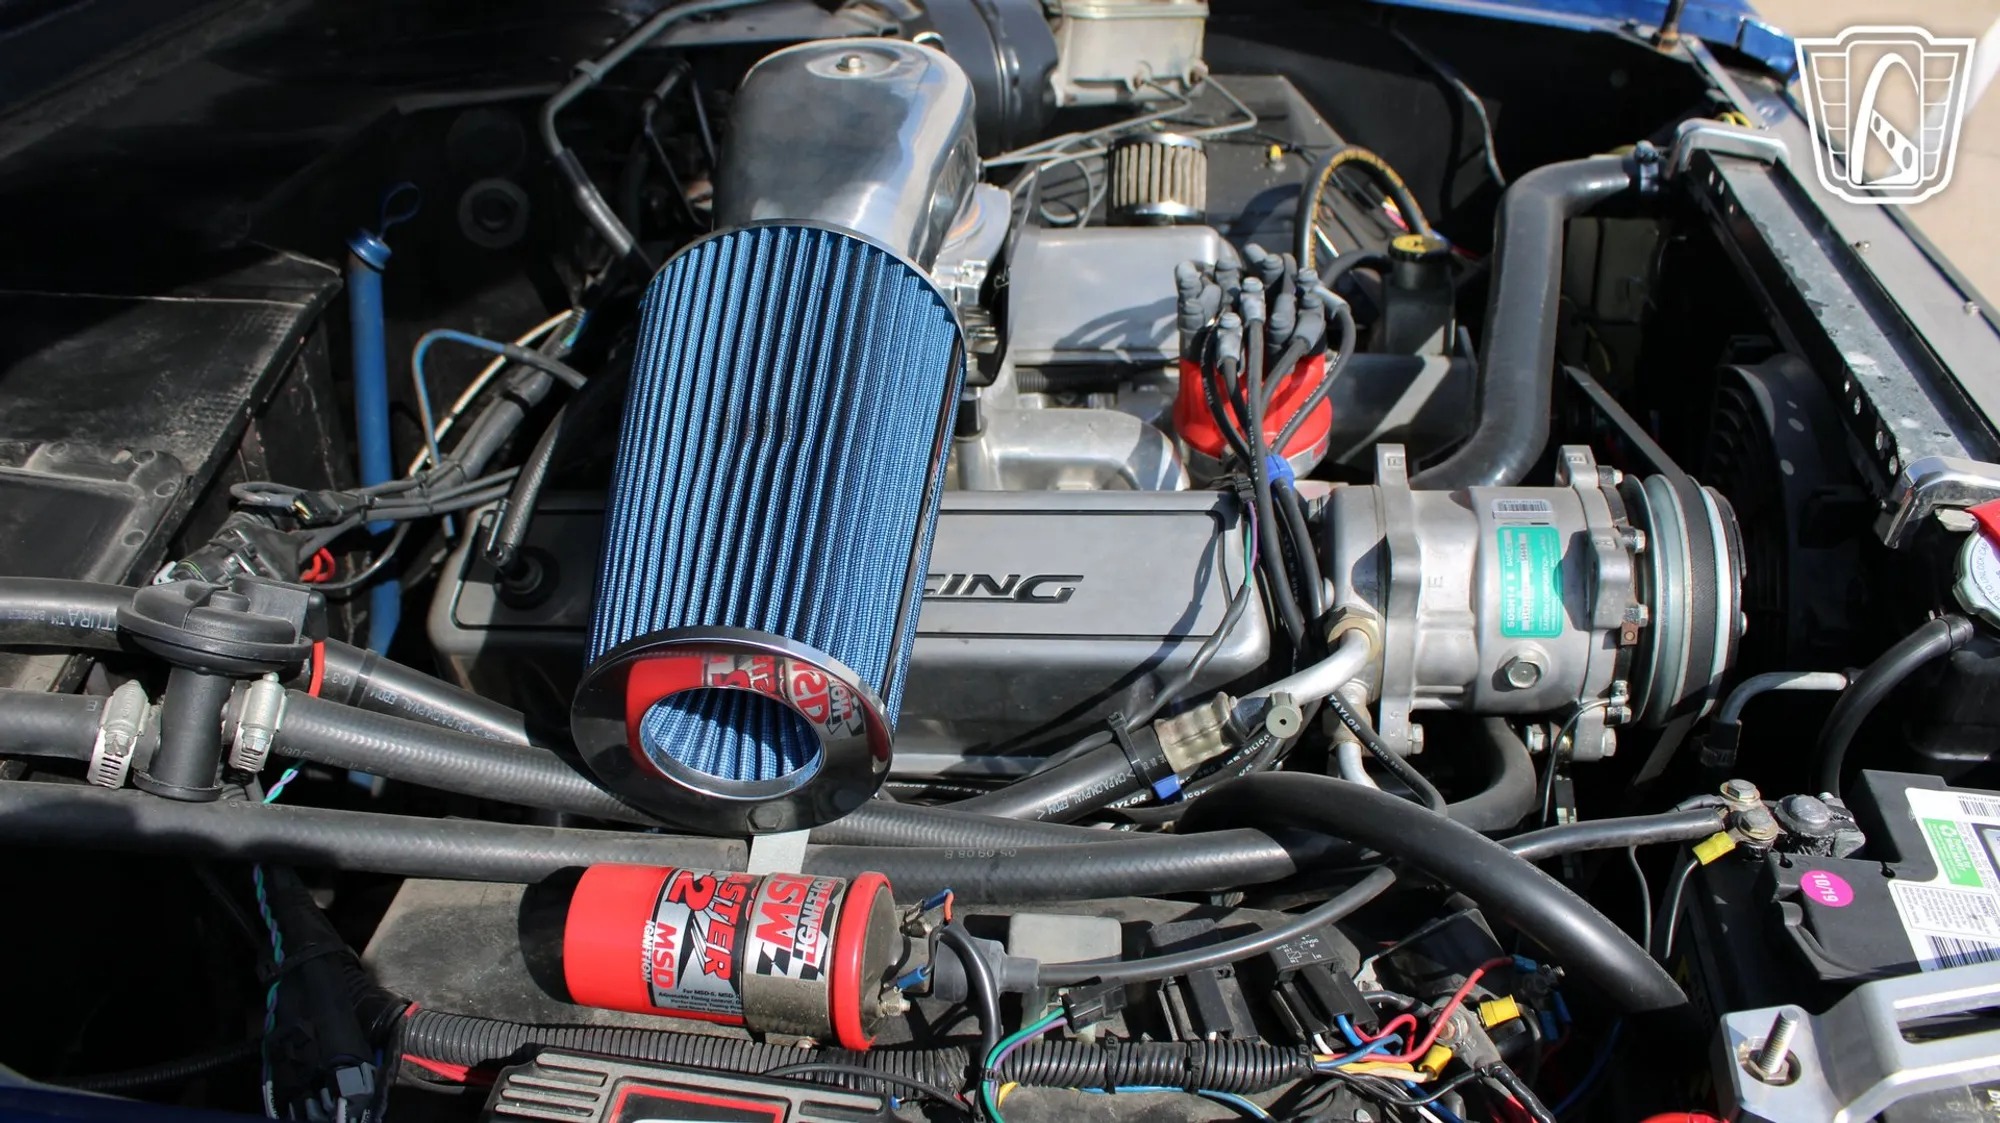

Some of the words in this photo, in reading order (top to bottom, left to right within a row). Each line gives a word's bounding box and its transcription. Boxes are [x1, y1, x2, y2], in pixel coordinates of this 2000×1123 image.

[1329, 694, 1361, 732] TAYLOR
[1108, 793, 1147, 809] AYLOR
[668, 870, 718, 912] 2
[1811, 873, 1840, 903] 10/19
[796, 879, 833, 955] IGNITIO
[641, 919, 656, 983] IGNITION
[652, 921, 678, 989] MSD
